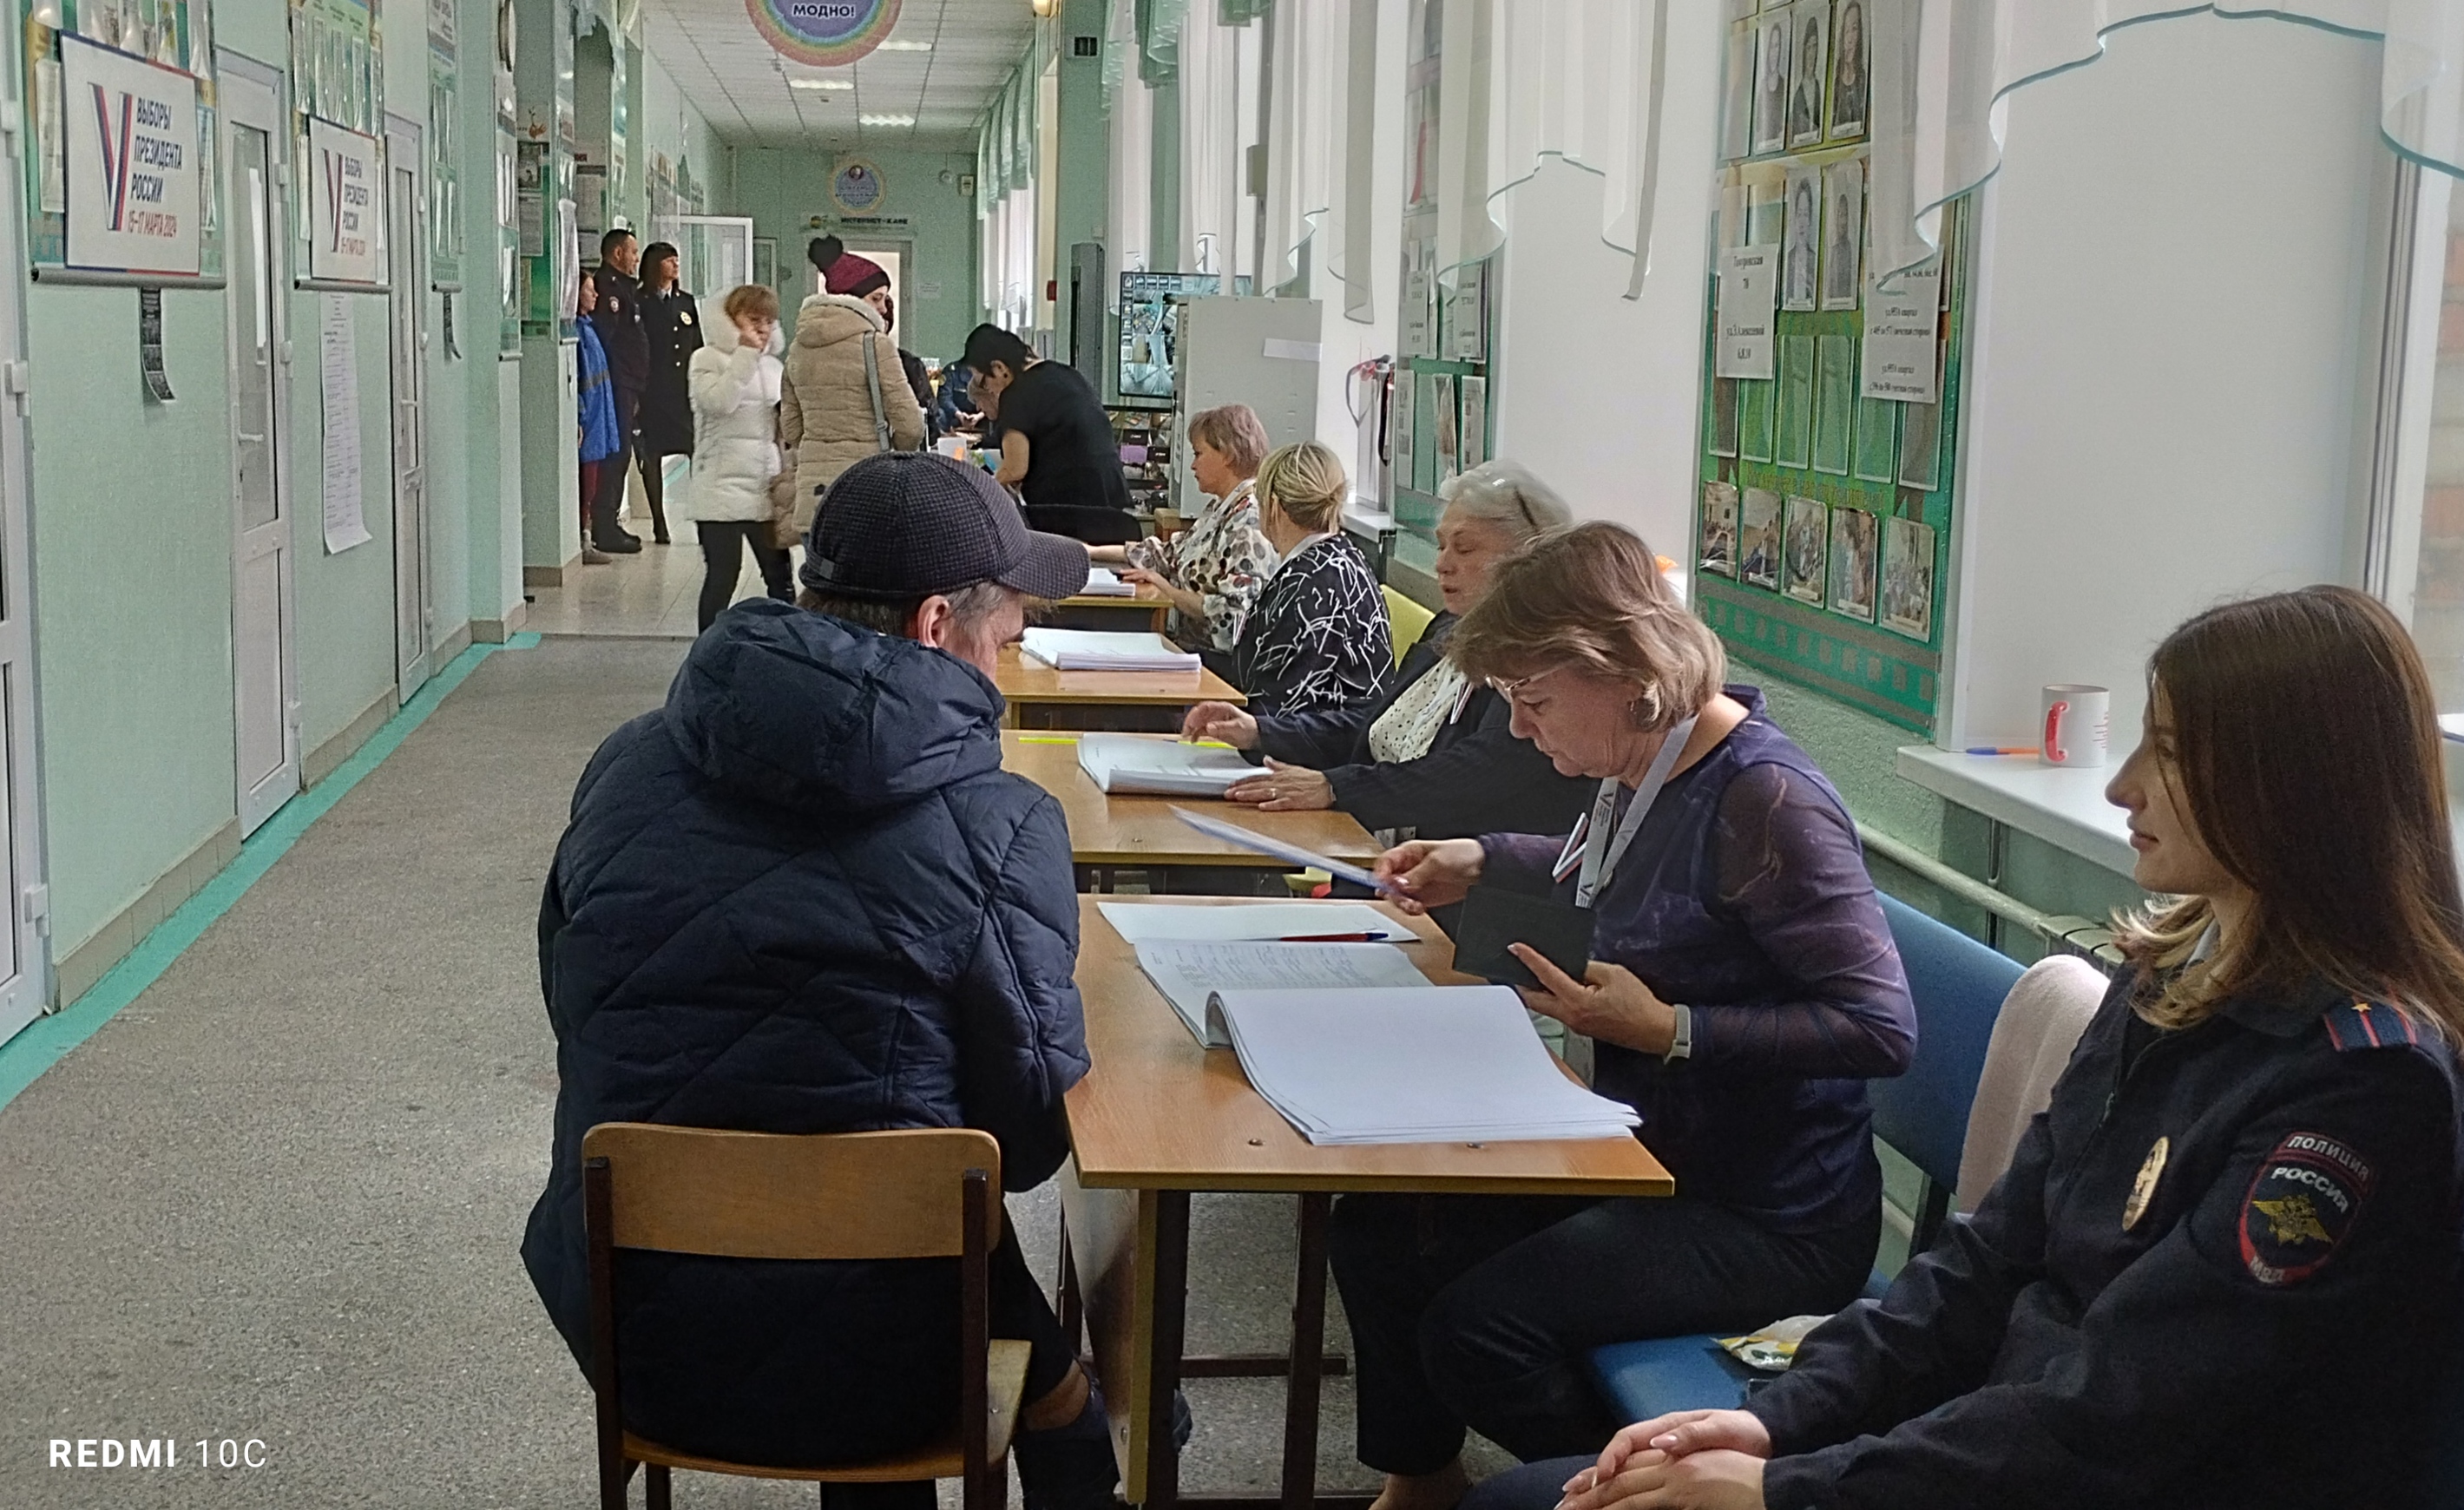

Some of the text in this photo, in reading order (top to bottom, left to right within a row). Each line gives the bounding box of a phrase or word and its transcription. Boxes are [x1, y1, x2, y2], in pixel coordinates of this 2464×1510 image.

[792, 3, 855, 18] МОДНО!
[137, 97, 172, 130] ВЫБОРЫ
[134, 135, 183, 171] ПРЕЗИДЕНТА
[130, 173, 163, 203] РОССИИ
[144, 212, 163, 236] МАРТА
[2287, 1136, 2369, 1182] ПОЛИЦИЯ
[2270, 1167, 2349, 1213] РОССИЯ
